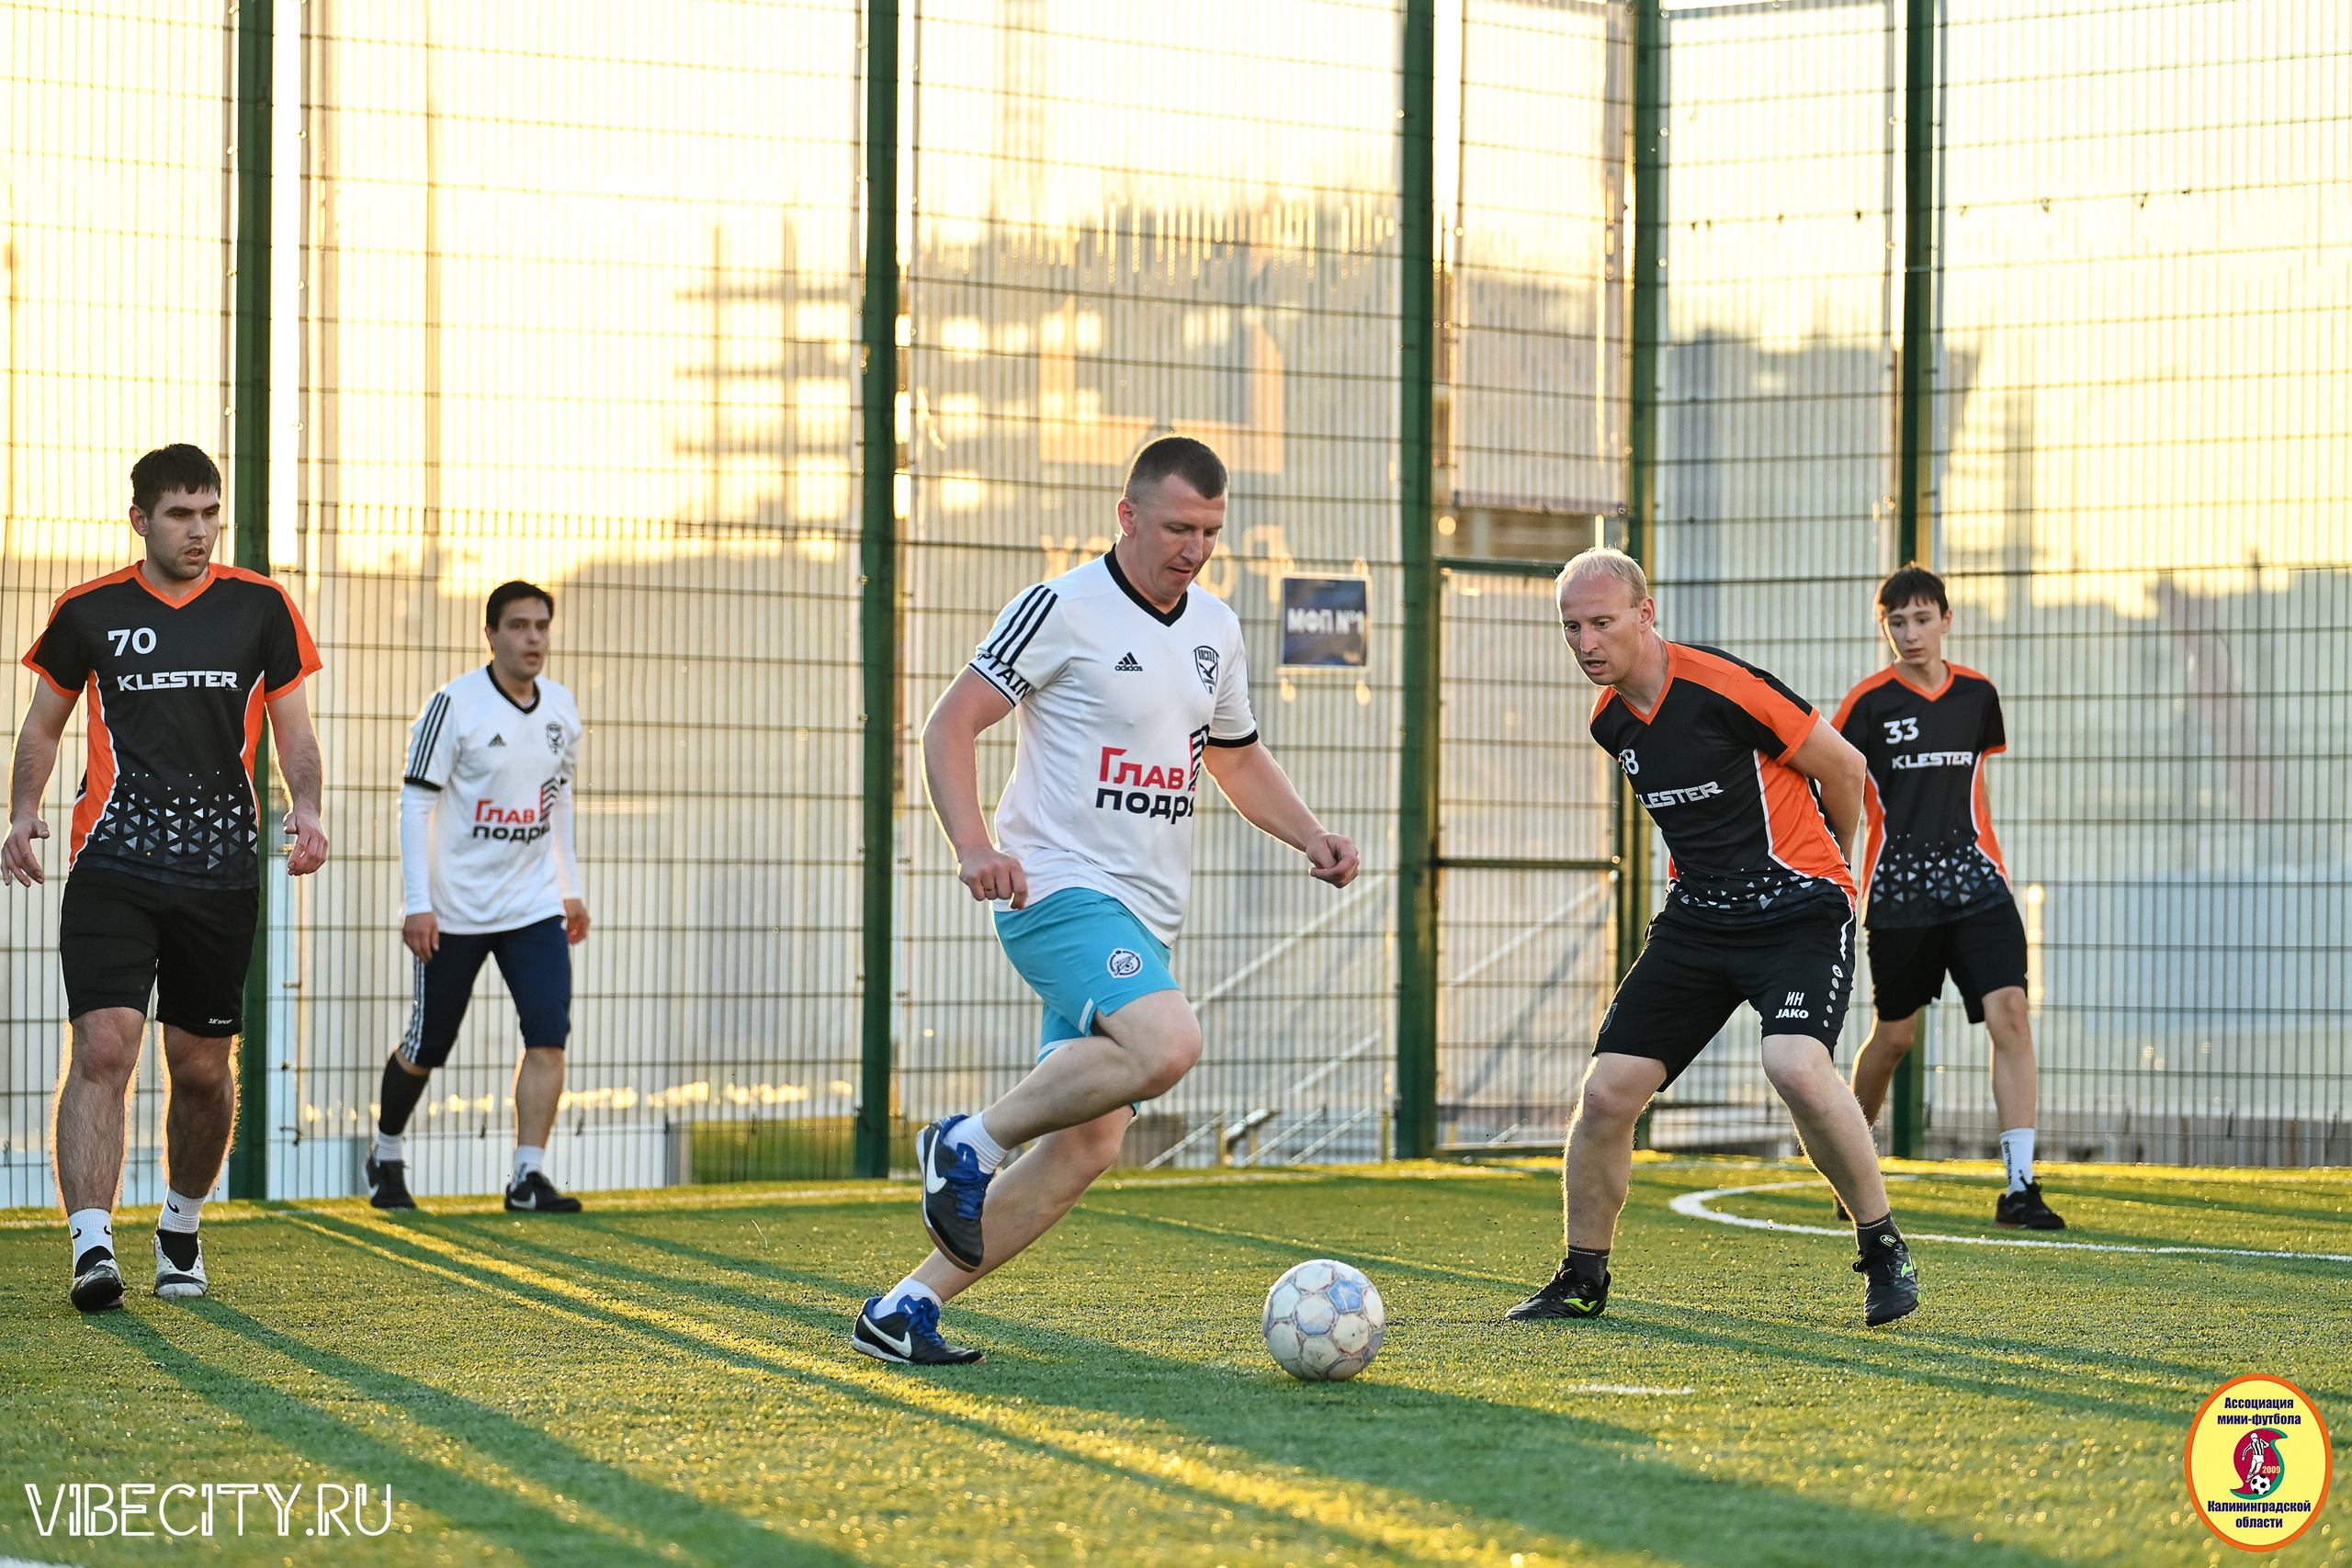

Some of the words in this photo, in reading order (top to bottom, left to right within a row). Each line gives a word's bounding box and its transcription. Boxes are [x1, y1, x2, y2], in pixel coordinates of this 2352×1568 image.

[1287, 607, 1333, 634] МФП
[107, 627, 157, 657] 70
[117, 670, 238, 692] KLESTER
[1883, 716, 1919, 744] 33
[1892, 750, 1973, 770] KLESTER
[1636, 781, 1724, 808] LESTER
[1775, 1008, 1810, 1019] JAKO
